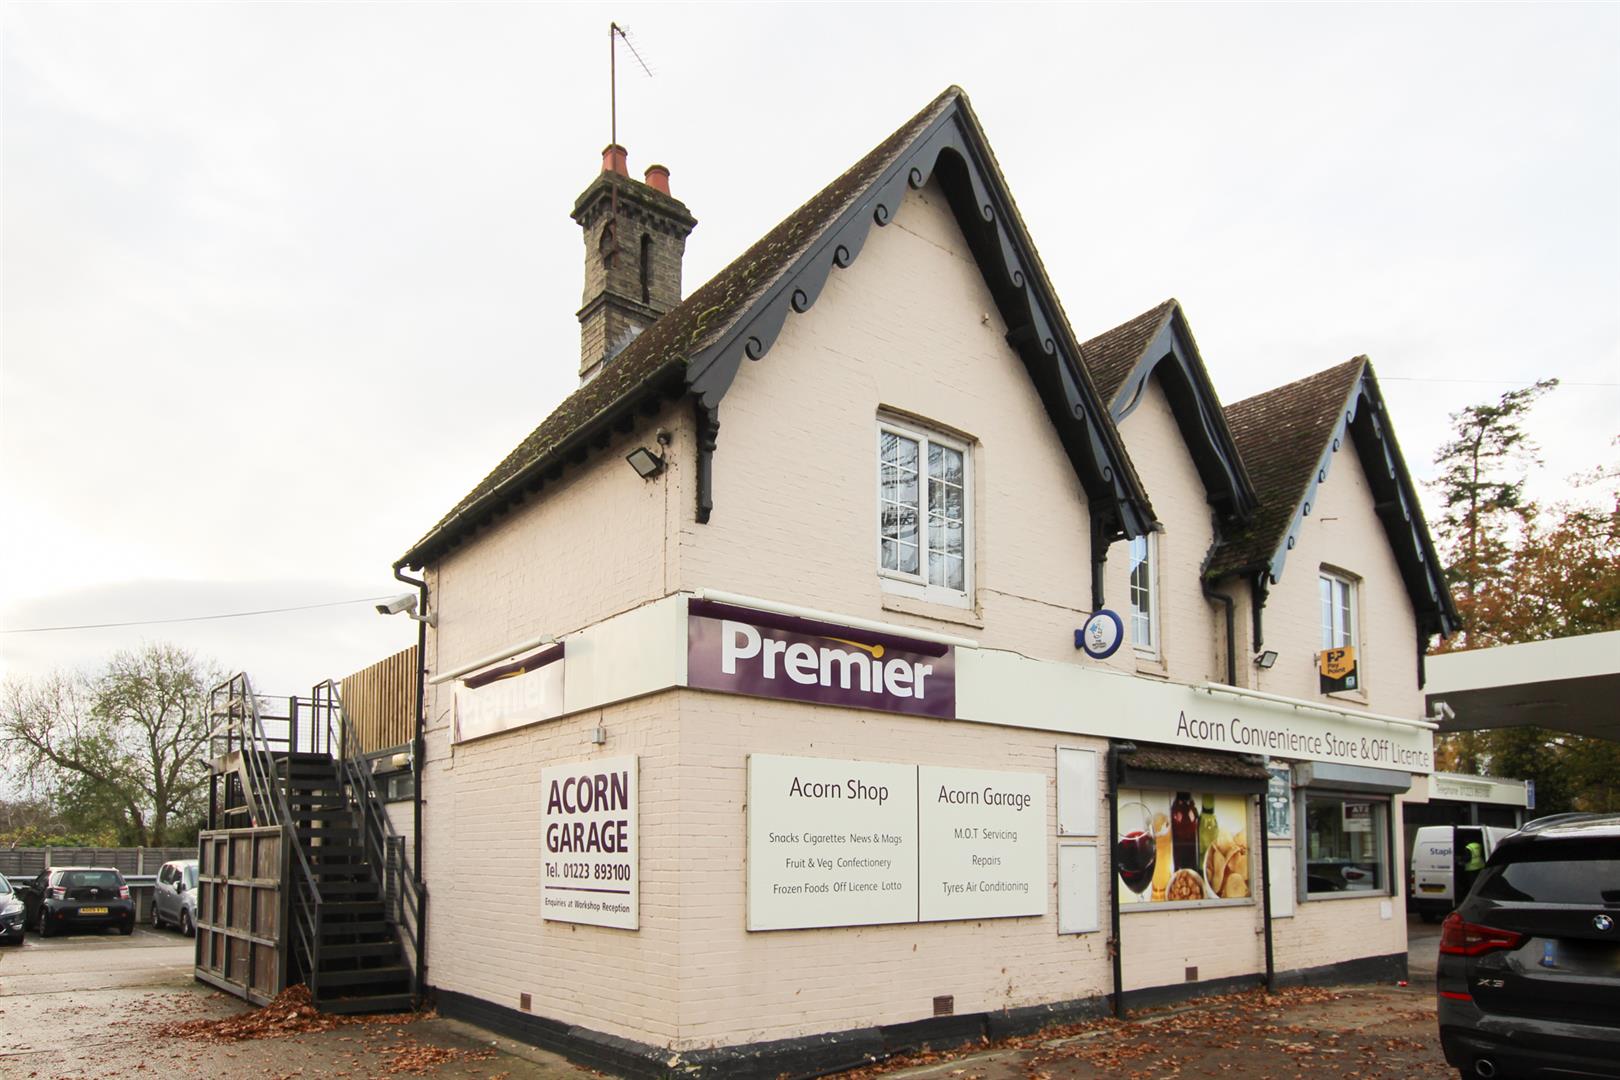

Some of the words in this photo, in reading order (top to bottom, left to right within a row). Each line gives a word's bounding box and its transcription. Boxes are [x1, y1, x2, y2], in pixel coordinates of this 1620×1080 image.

[722, 620, 933, 699] Premier
[1177, 710, 1225, 742] Acorn
[1230, 718, 1321, 754] Convenience
[1325, 732, 1357, 759] Store
[1391, 742, 1429, 767] Licence
[547, 771, 628, 815] ACORN
[790, 777, 841, 799] Acorn
[847, 779, 889, 806] Shop
[938, 785, 979, 805] Acorn
[983, 787, 1031, 811] Garage
[547, 820, 628, 854] GARAGE
[769, 833, 799, 843] Snacks
[803, 833, 846, 846] Cigarettes
[850, 834, 872, 843] News
[873, 834, 879, 843] &
[881, 834, 902, 846] Mags
[954, 828, 978, 839] M.O.T
[982, 828, 1018, 843] Servicing
[786, 858, 805, 869] Fruit
[808, 858, 815, 868] &
[817, 858, 833, 870] Veg
[837, 857, 891, 870] Confectionery
[972, 855, 1001, 868] Repairs
[545, 862, 560, 878] Tel.
[563, 863, 590, 879] 01223
[594, 863, 631, 881] 893100
[773, 884, 802, 894] Frozen
[804, 883, 829, 894] Foods
[833, 882, 847, 892] Off
[849, 882, 878, 892] Licence
[881, 881, 902, 891] Lotto
[943, 882, 964, 896] Tyres
[966, 882, 977, 892] Air
[979, 881, 1029, 894] Conditioning
[545, 897, 566, 907] Enquiries
[568, 900, 573, 908] at
[575, 900, 600, 912] Workshop
[602, 902, 630, 914] Reception
[1477, 979, 1505, 988] X3
